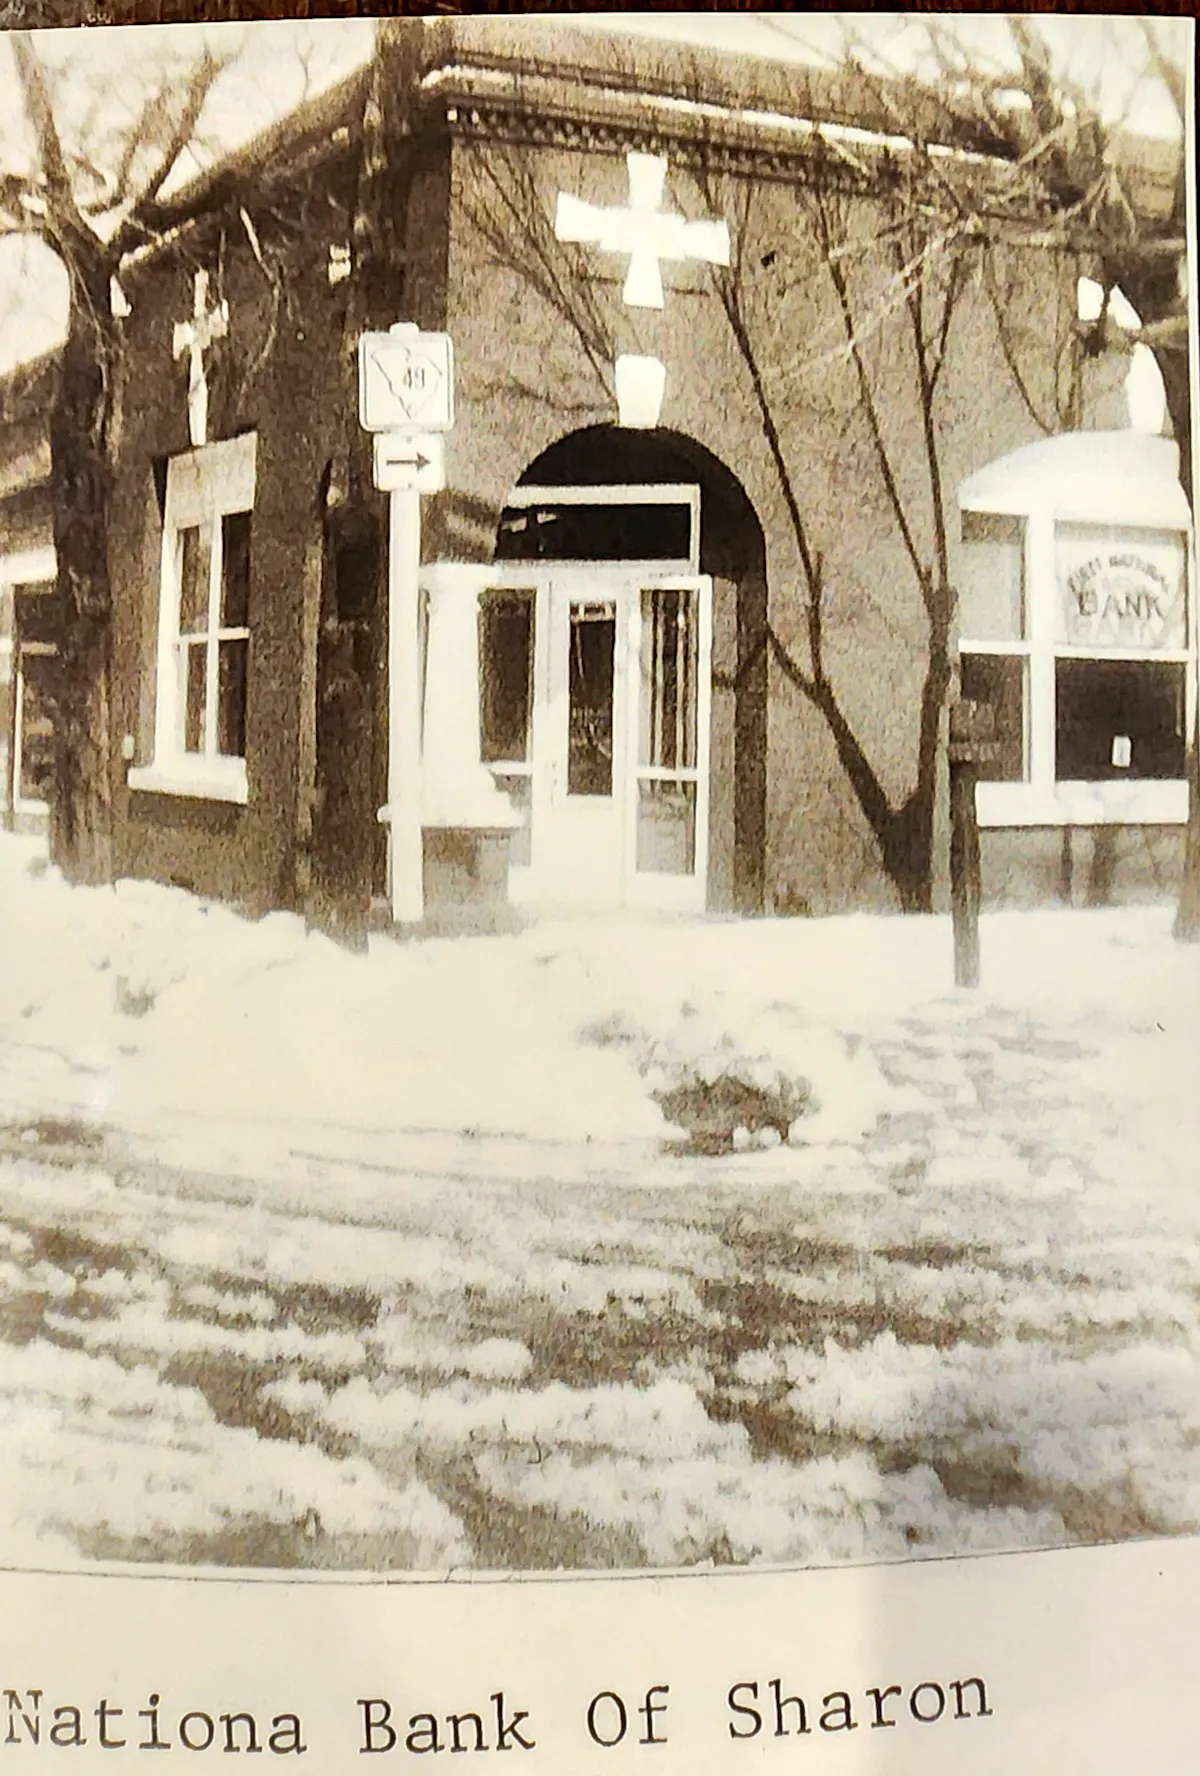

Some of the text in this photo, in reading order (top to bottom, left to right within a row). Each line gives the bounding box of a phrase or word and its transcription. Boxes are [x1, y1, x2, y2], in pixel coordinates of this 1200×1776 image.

[403, 367, 425, 388] 49
[1078, 590, 1165, 620] BANK
[4, 1677, 993, 1755] Nationa Bank Of Sharon
